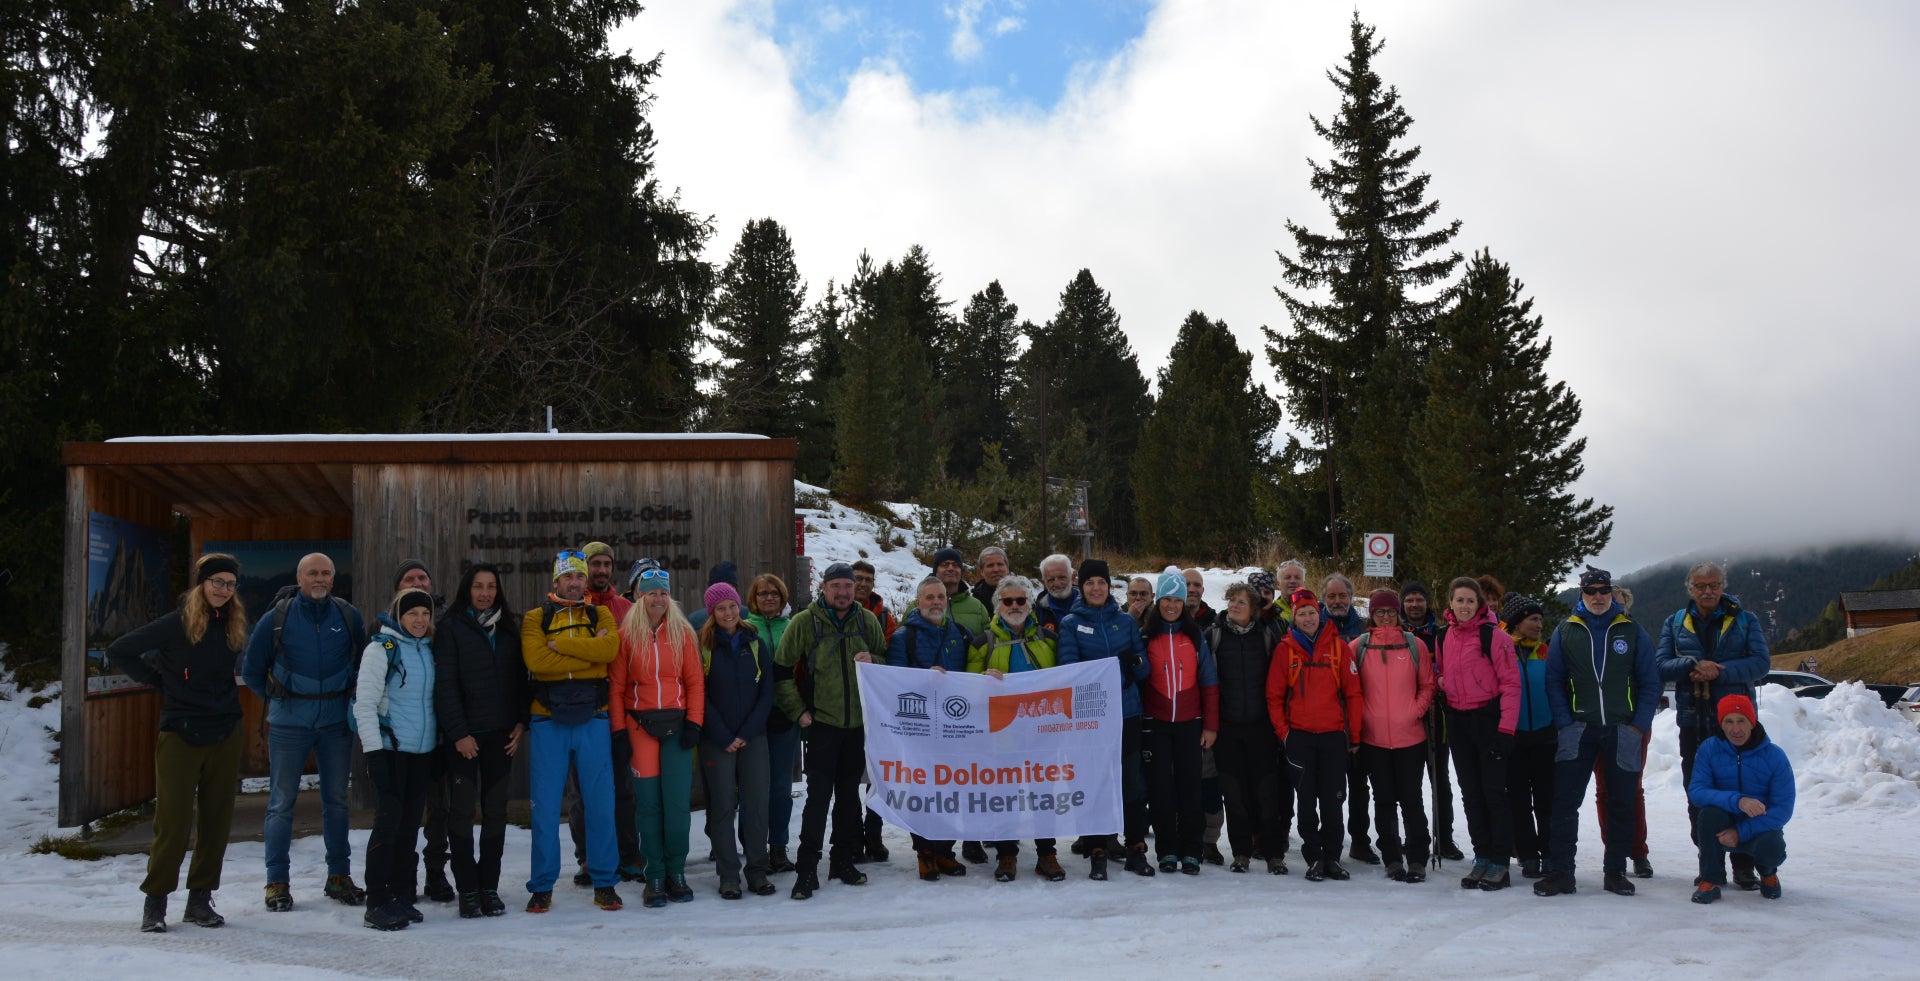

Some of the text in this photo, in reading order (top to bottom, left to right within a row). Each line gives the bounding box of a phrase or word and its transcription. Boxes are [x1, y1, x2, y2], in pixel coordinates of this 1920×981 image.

[467, 507, 521, 523] Parch
[526, 506, 594, 523] natural
[470, 532, 568, 552] Naturpark
[879, 760, 1075, 785] The Dolomites
[968, 788, 1085, 816] Heritage
